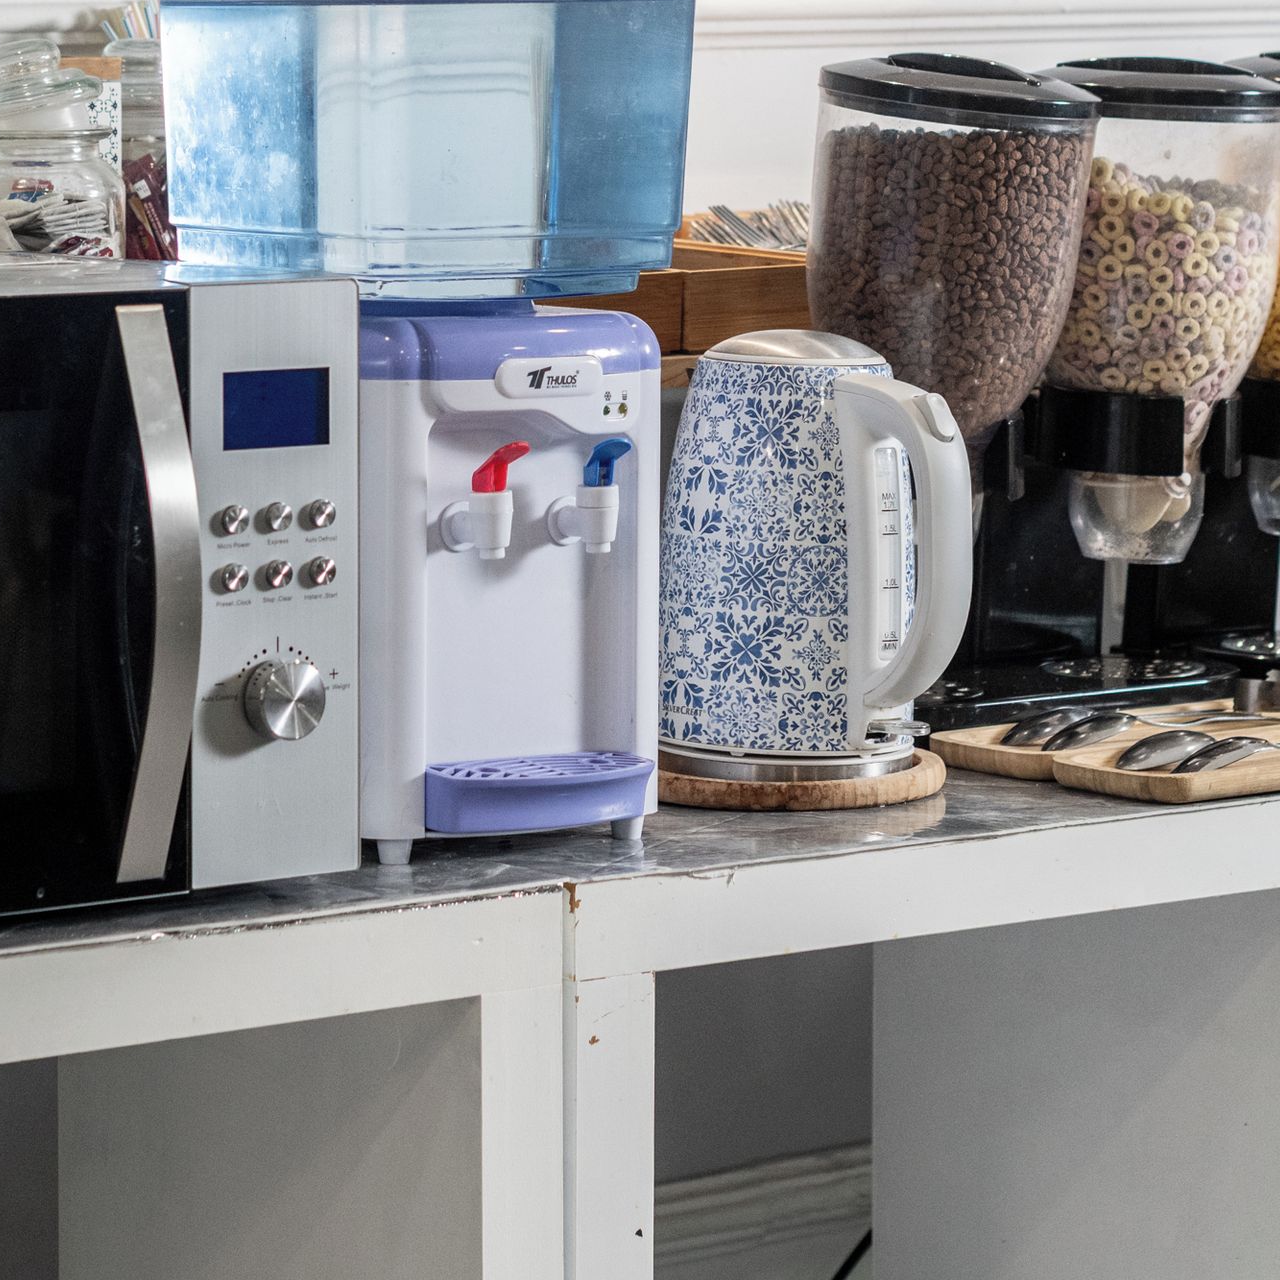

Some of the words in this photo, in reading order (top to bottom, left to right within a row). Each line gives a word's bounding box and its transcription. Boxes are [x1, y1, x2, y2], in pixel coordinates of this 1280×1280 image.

[547, 374, 577, 385] THULOS
[882, 493, 896, 501] MAX
[884, 525, 897, 533] 1.5L
[885, 578, 898, 586] 1.0L
